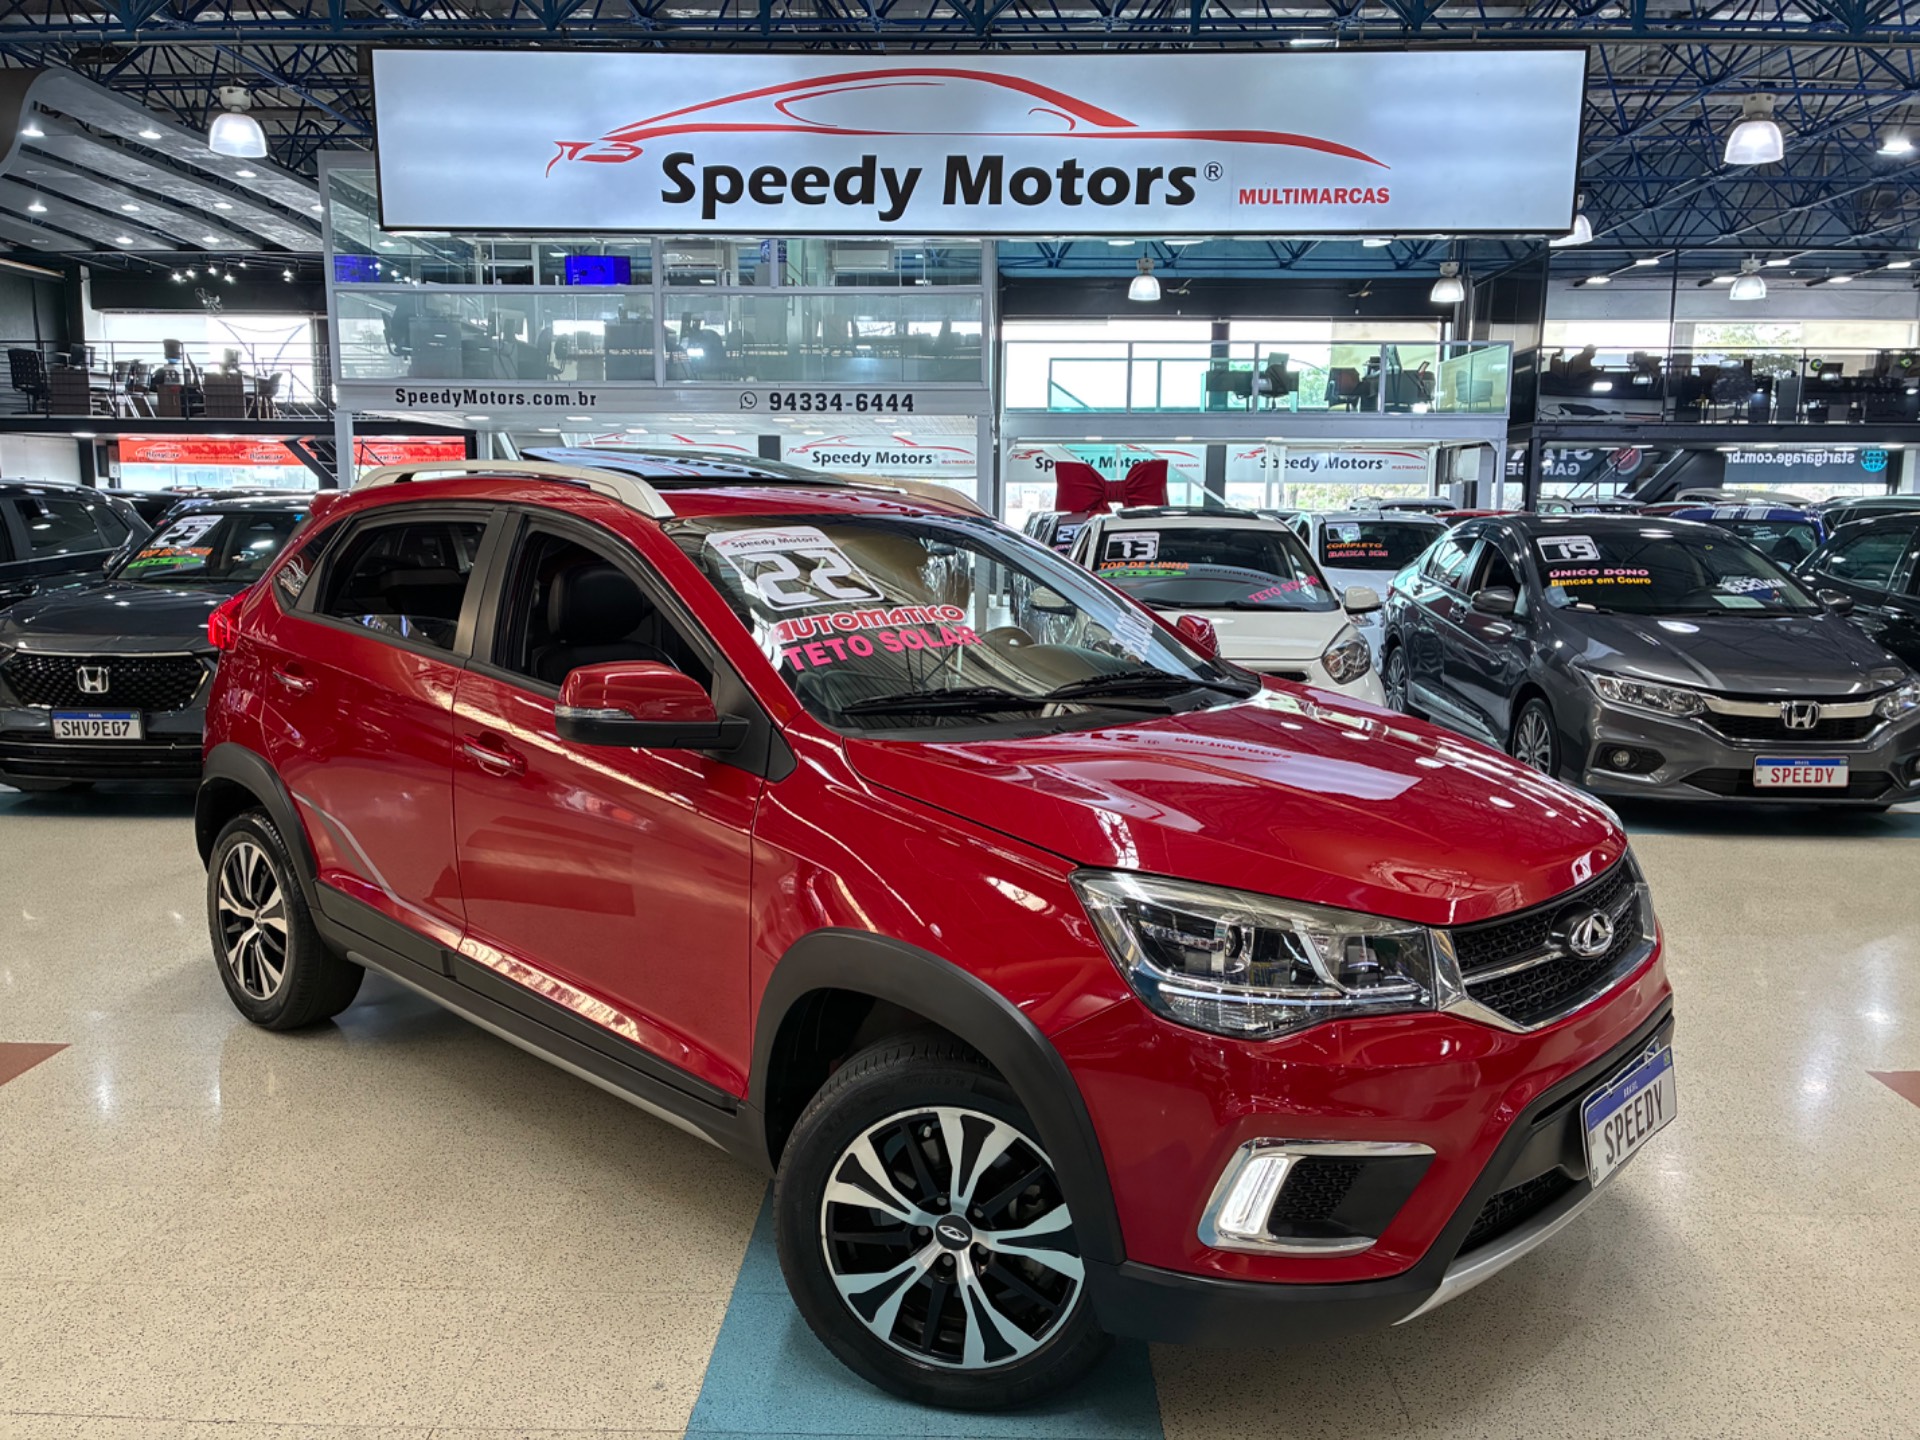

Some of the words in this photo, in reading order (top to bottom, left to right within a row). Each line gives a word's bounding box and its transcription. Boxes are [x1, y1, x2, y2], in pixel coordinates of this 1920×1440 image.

[661, 152, 922, 222] Speedy
[1238, 187, 1390, 205] MULTIMARCAS
[395, 388, 597, 408] SpeedyMotors.com.br
[769, 392, 914, 413] 94334-6444
[812, 450, 871, 467] Speedy
[875, 451, 933, 465] Motors
[1035, 456, 1095, 473] Spy
[1324, 456, 1384, 470] Motors
[160, 525, 209, 547] 23
[731, 536, 776, 549] Speedy
[778, 535, 820, 546] Motors
[1121, 541, 1156, 559] 13
[1100, 562, 1126, 570] TOP
[1128, 561, 1146, 569] DE
[1149, 561, 1190, 570] LINHA
[1549, 568, 1600, 578] ÚNICO
[1604, 568, 1649, 576] DONO
[741, 549, 873, 605] 22
[1551, 578, 1594, 587] Bancos
[1617, 576, 1652, 584] Couro
[1248, 587, 1281, 603] TETO
[782, 637, 874, 671] TETO
[878, 626, 983, 651] SOLAR
[1770, 767, 1835, 784] SPEEDY
[1603, 1080, 1663, 1166] SPEEDY
